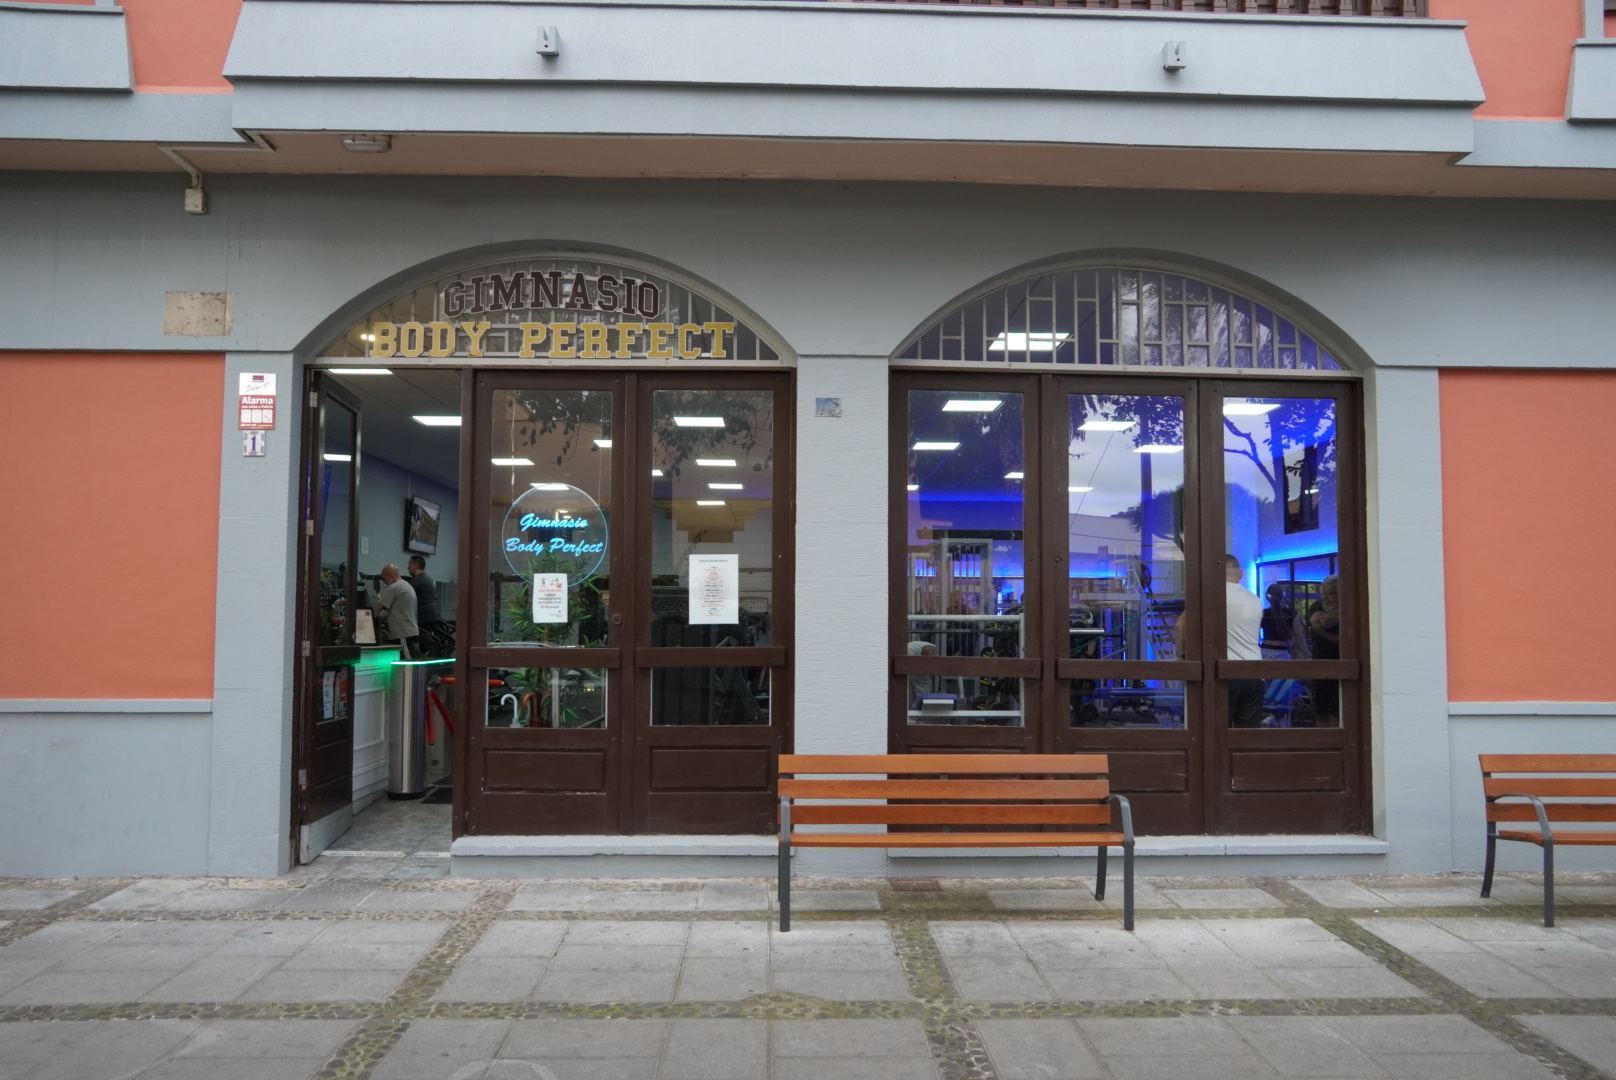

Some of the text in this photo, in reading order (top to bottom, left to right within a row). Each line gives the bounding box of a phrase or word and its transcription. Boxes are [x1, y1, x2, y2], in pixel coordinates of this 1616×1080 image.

[442, 270, 660, 319] GIMNASIO
[370, 321, 734, 359] BODY PERFECT
[242, 396, 273, 404] Alarma
[251, 435, 256, 451] 1
[520, 513, 588, 531] Gimnasio
[505, 537, 603, 556] Body Perfect
